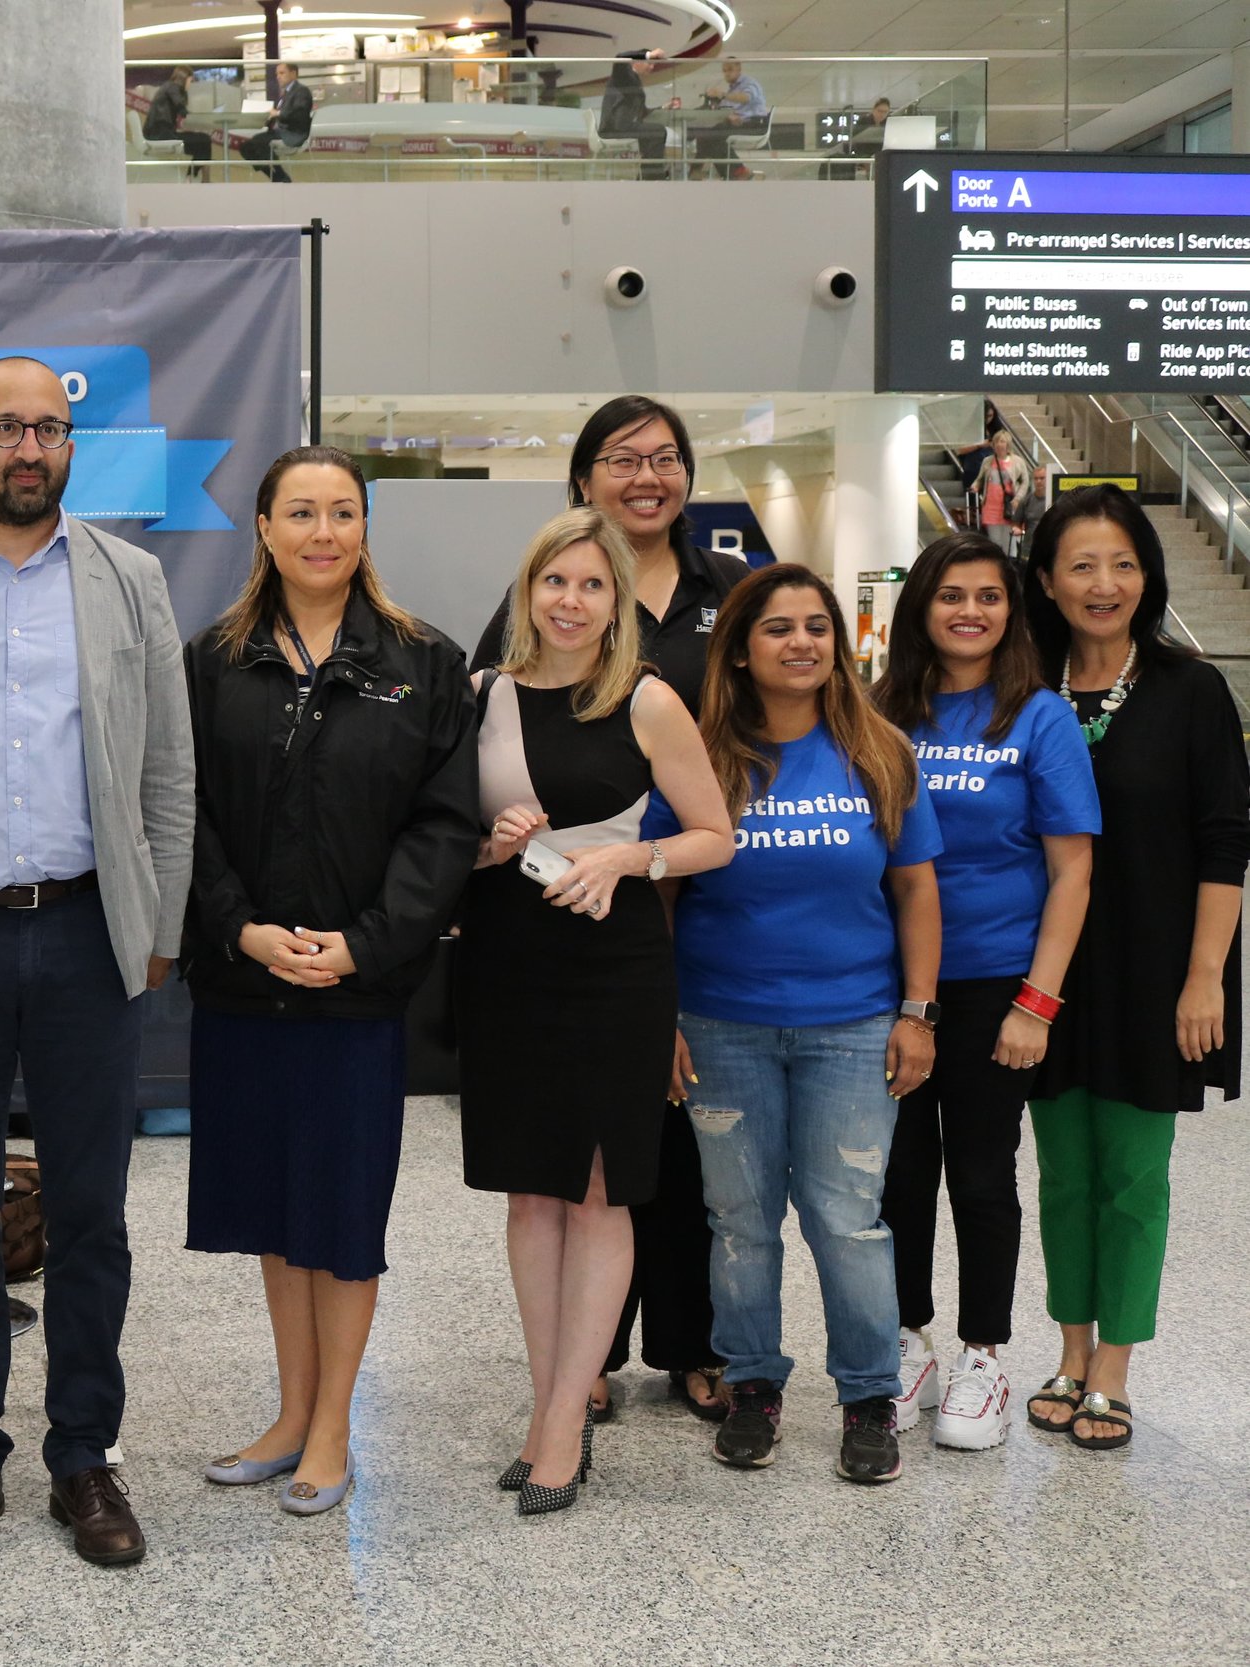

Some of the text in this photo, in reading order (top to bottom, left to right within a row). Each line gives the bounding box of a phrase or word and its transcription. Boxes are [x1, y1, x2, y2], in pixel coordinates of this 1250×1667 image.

[958, 175, 993, 190] Door
[958, 193, 998, 208] Porte
[1007, 177, 1032, 208] A
[1007, 232, 1250, 251] Pre-arranged Services Services
[985, 296, 1077, 311] Public Buses
[1161, 297, 1248, 312] Out of Town
[986, 314, 1101, 332] Autobus publics
[1162, 315, 1223, 331] Services
[984, 343, 1088, 358] Hotel Shuttles
[1160, 344, 1192, 359] Ride
[1195, 344, 1224, 361] App
[983, 361, 1110, 376] Navettes d'hôtels
[1160, 362, 1197, 377] Zone
[1199, 362, 1235, 379] appli
[922, 770, 985, 792] ario
[742, 793, 871, 817] stination
[734, 823, 850, 849] Ontario
